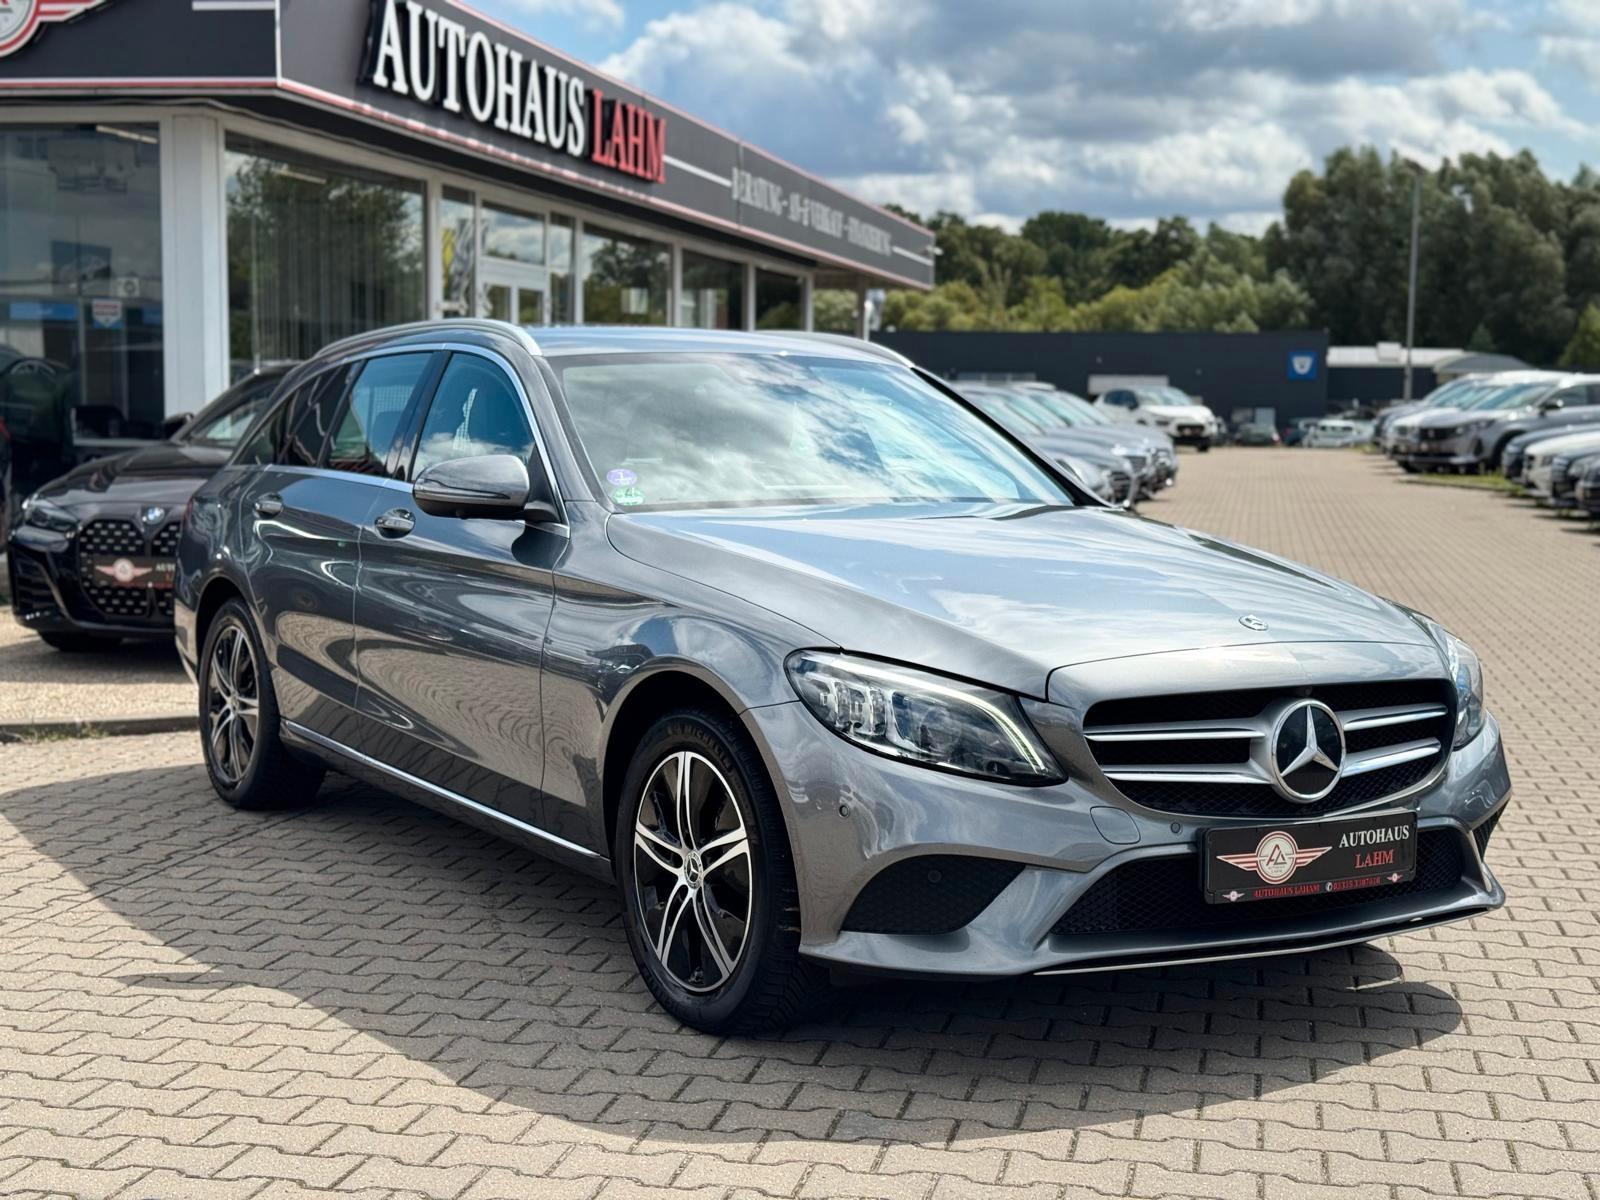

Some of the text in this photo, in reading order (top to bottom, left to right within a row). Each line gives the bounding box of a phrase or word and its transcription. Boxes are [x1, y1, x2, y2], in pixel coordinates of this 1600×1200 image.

[373, 0, 666, 184] AUTOHAUS LAHM
[1338, 825, 1410, 848] AUTOHAUS
[1354, 849, 1394, 869] LAHM
